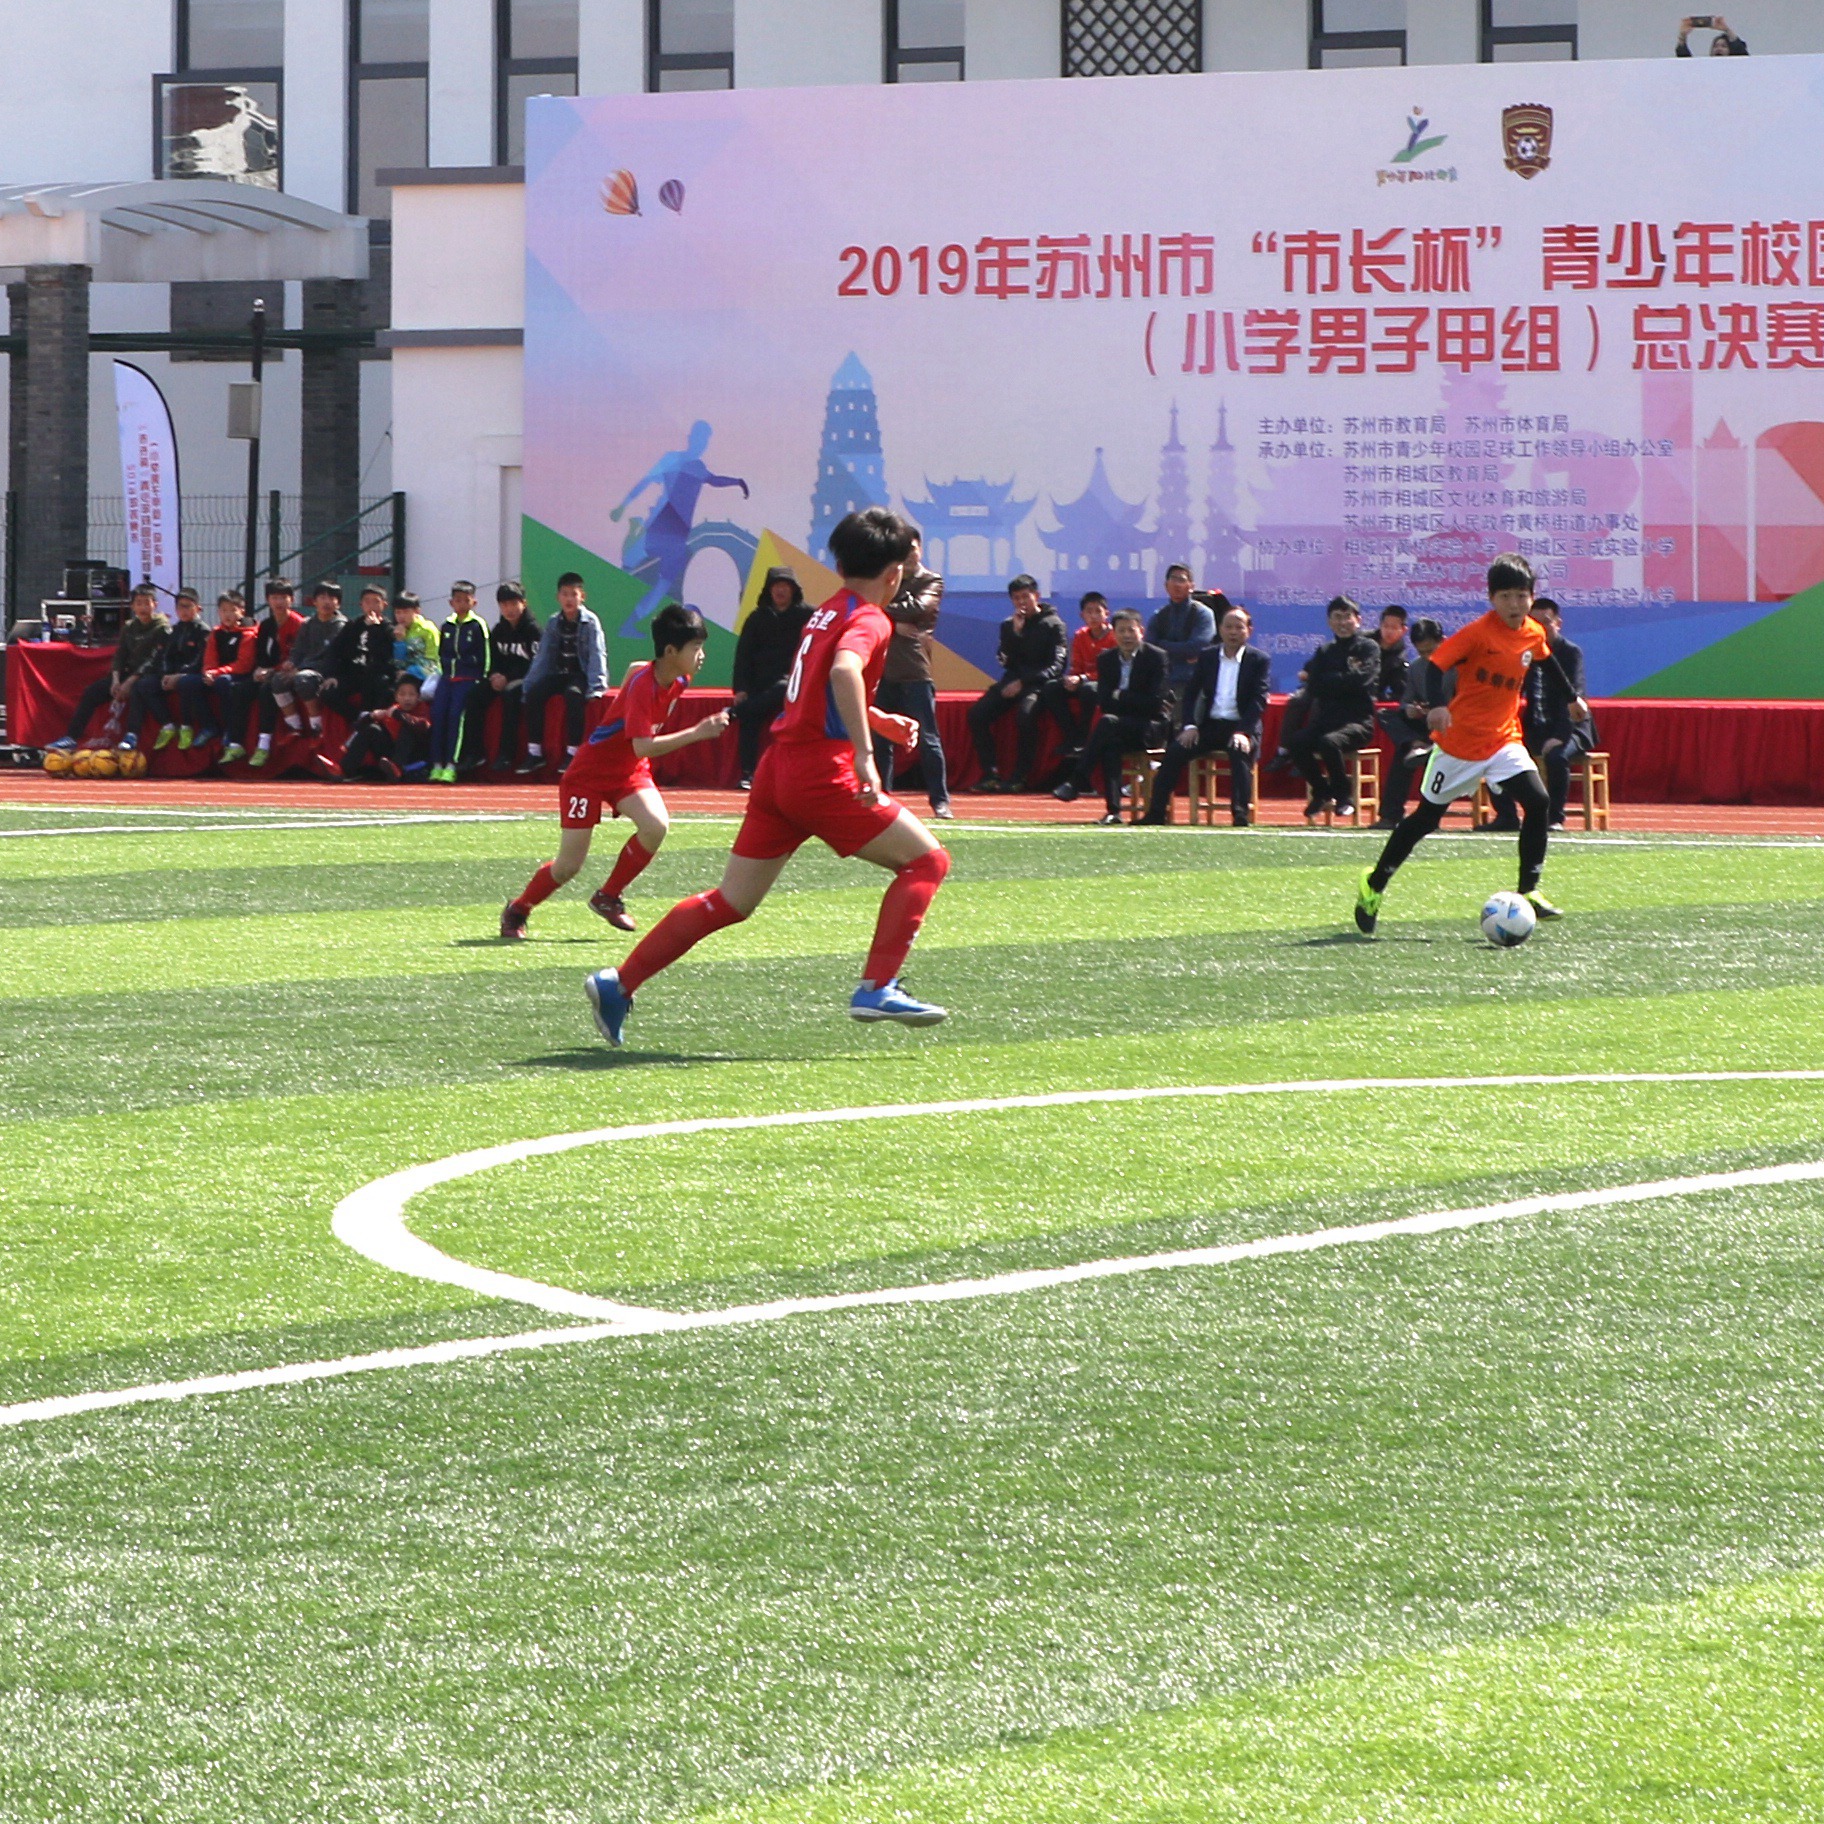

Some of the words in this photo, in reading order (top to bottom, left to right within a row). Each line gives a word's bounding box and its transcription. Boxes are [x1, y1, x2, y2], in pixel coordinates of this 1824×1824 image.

[1465, 415, 1569, 434] 苏州市体育局
[1343, 465, 1499, 484] 苏州市相城区教育局
[1343, 488, 1587, 509] 苏州市相城区文化体育和旅游局
[786, 633, 814, 704] 6
[1431, 771, 1445, 794] 8
[568, 796, 589, 819] 23
